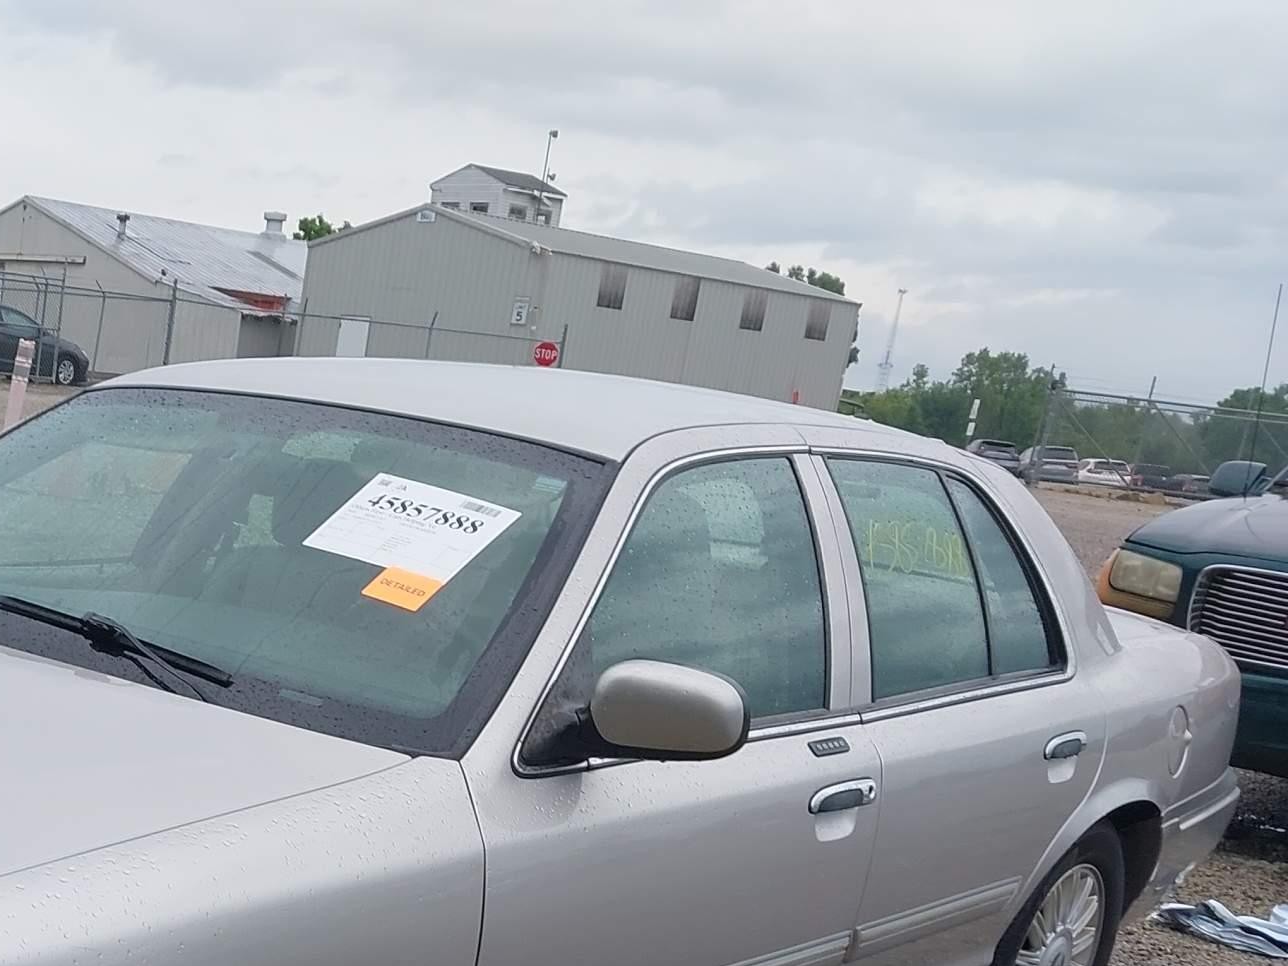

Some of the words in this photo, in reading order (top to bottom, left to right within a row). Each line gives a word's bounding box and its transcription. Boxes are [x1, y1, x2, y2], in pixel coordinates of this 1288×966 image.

[515, 311, 523, 322] 5
[535, 348, 558, 361] STOP
[368, 494, 485, 534] 45857888
[379, 577, 427, 598] DETAILED
